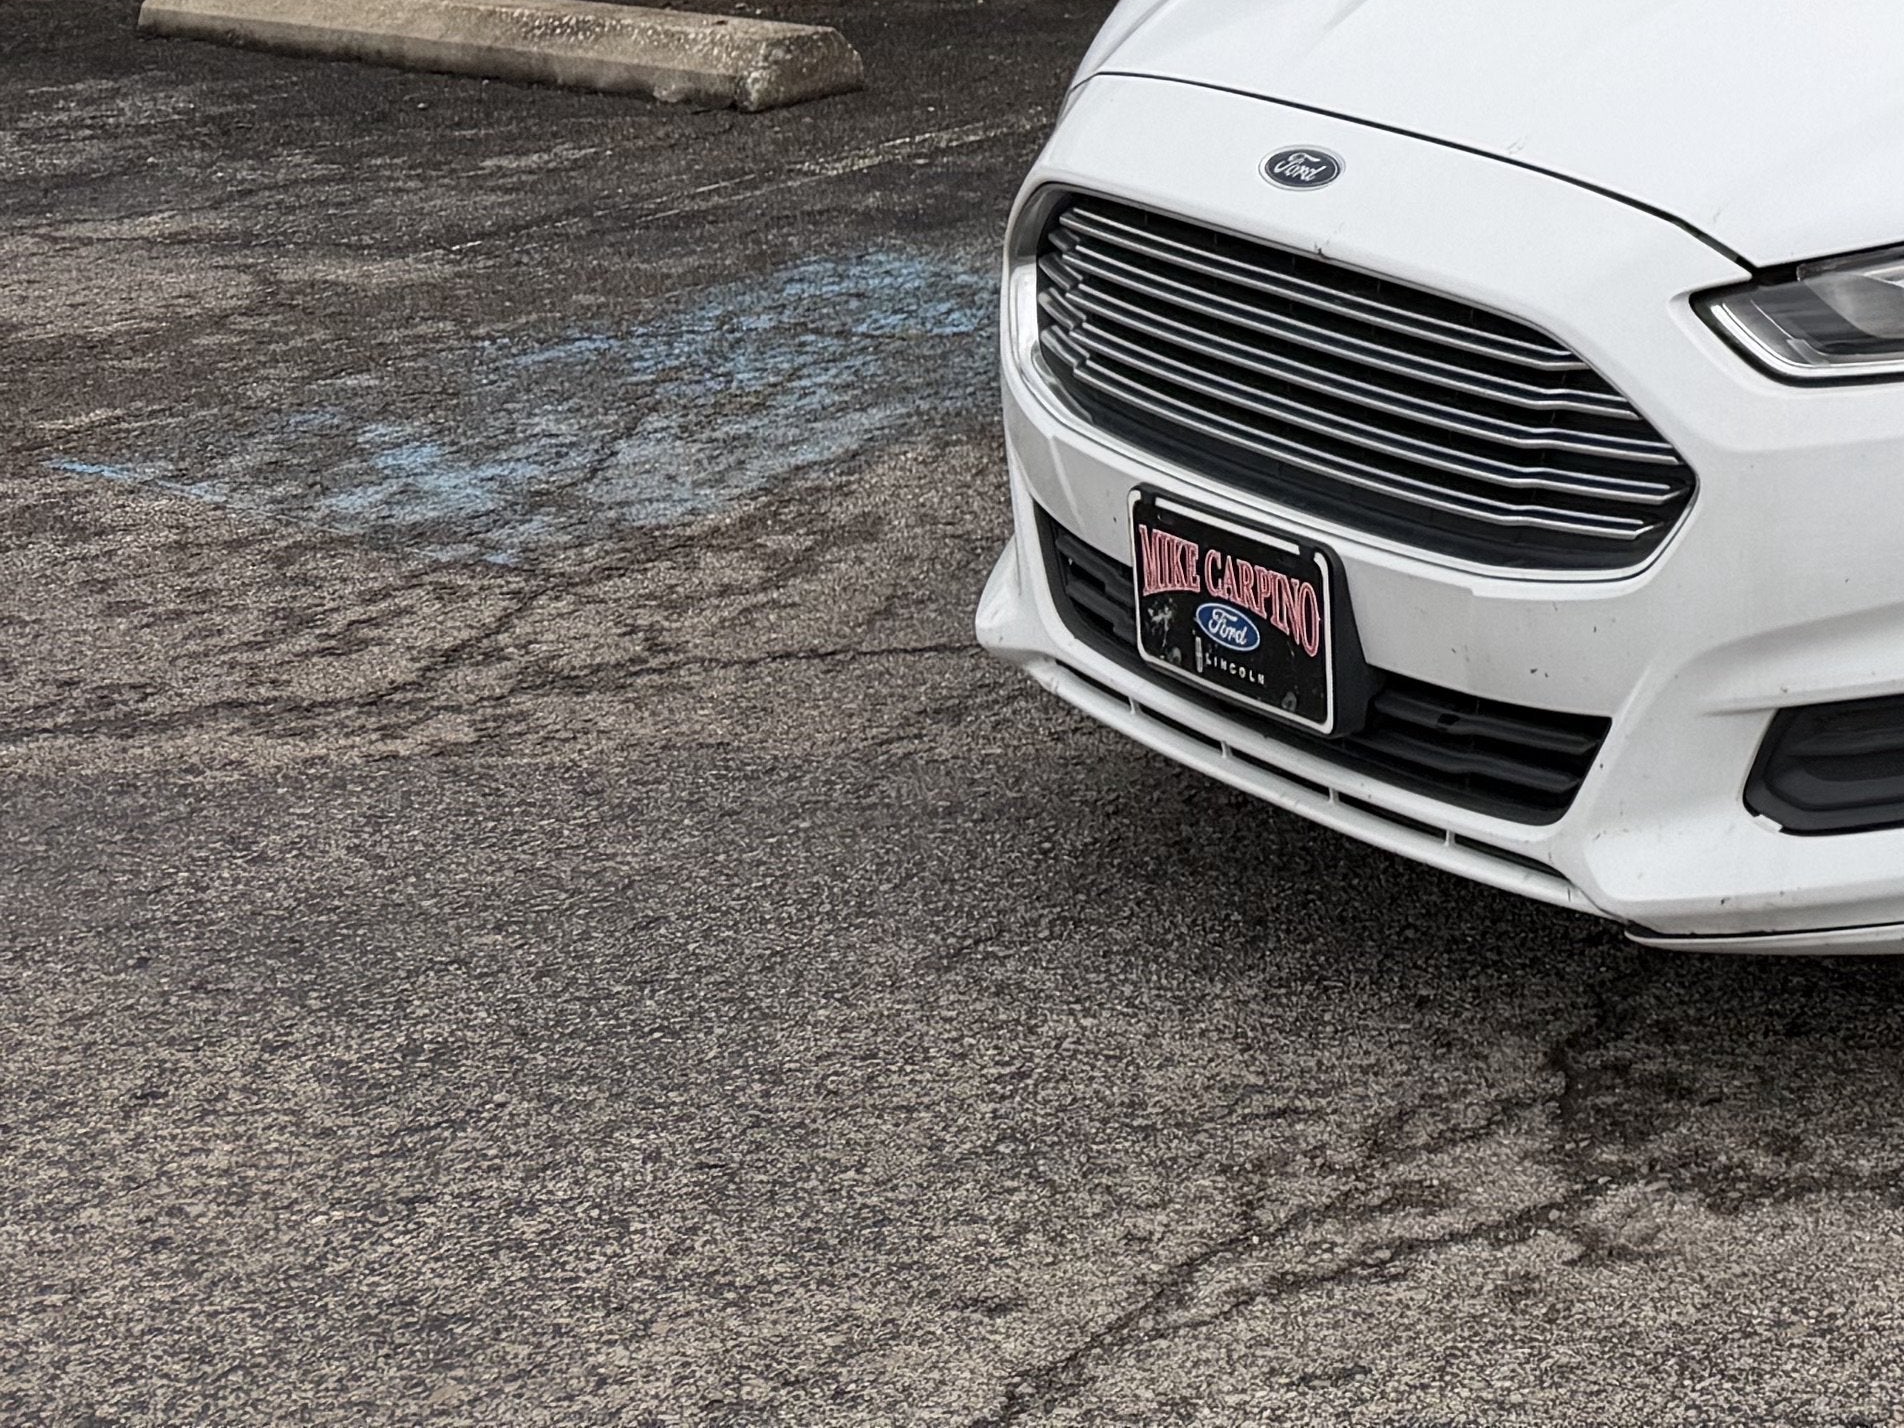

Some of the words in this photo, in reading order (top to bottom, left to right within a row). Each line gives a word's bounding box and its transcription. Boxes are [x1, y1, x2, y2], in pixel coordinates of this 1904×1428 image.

[1273, 152, 1327, 182] Ford
[1139, 524, 1201, 596] MIKE
[1204, 549, 1320, 657] CARPINO
[1208, 608, 1248, 646] Ford
[1205, 652, 1265, 685] LINCOLN
